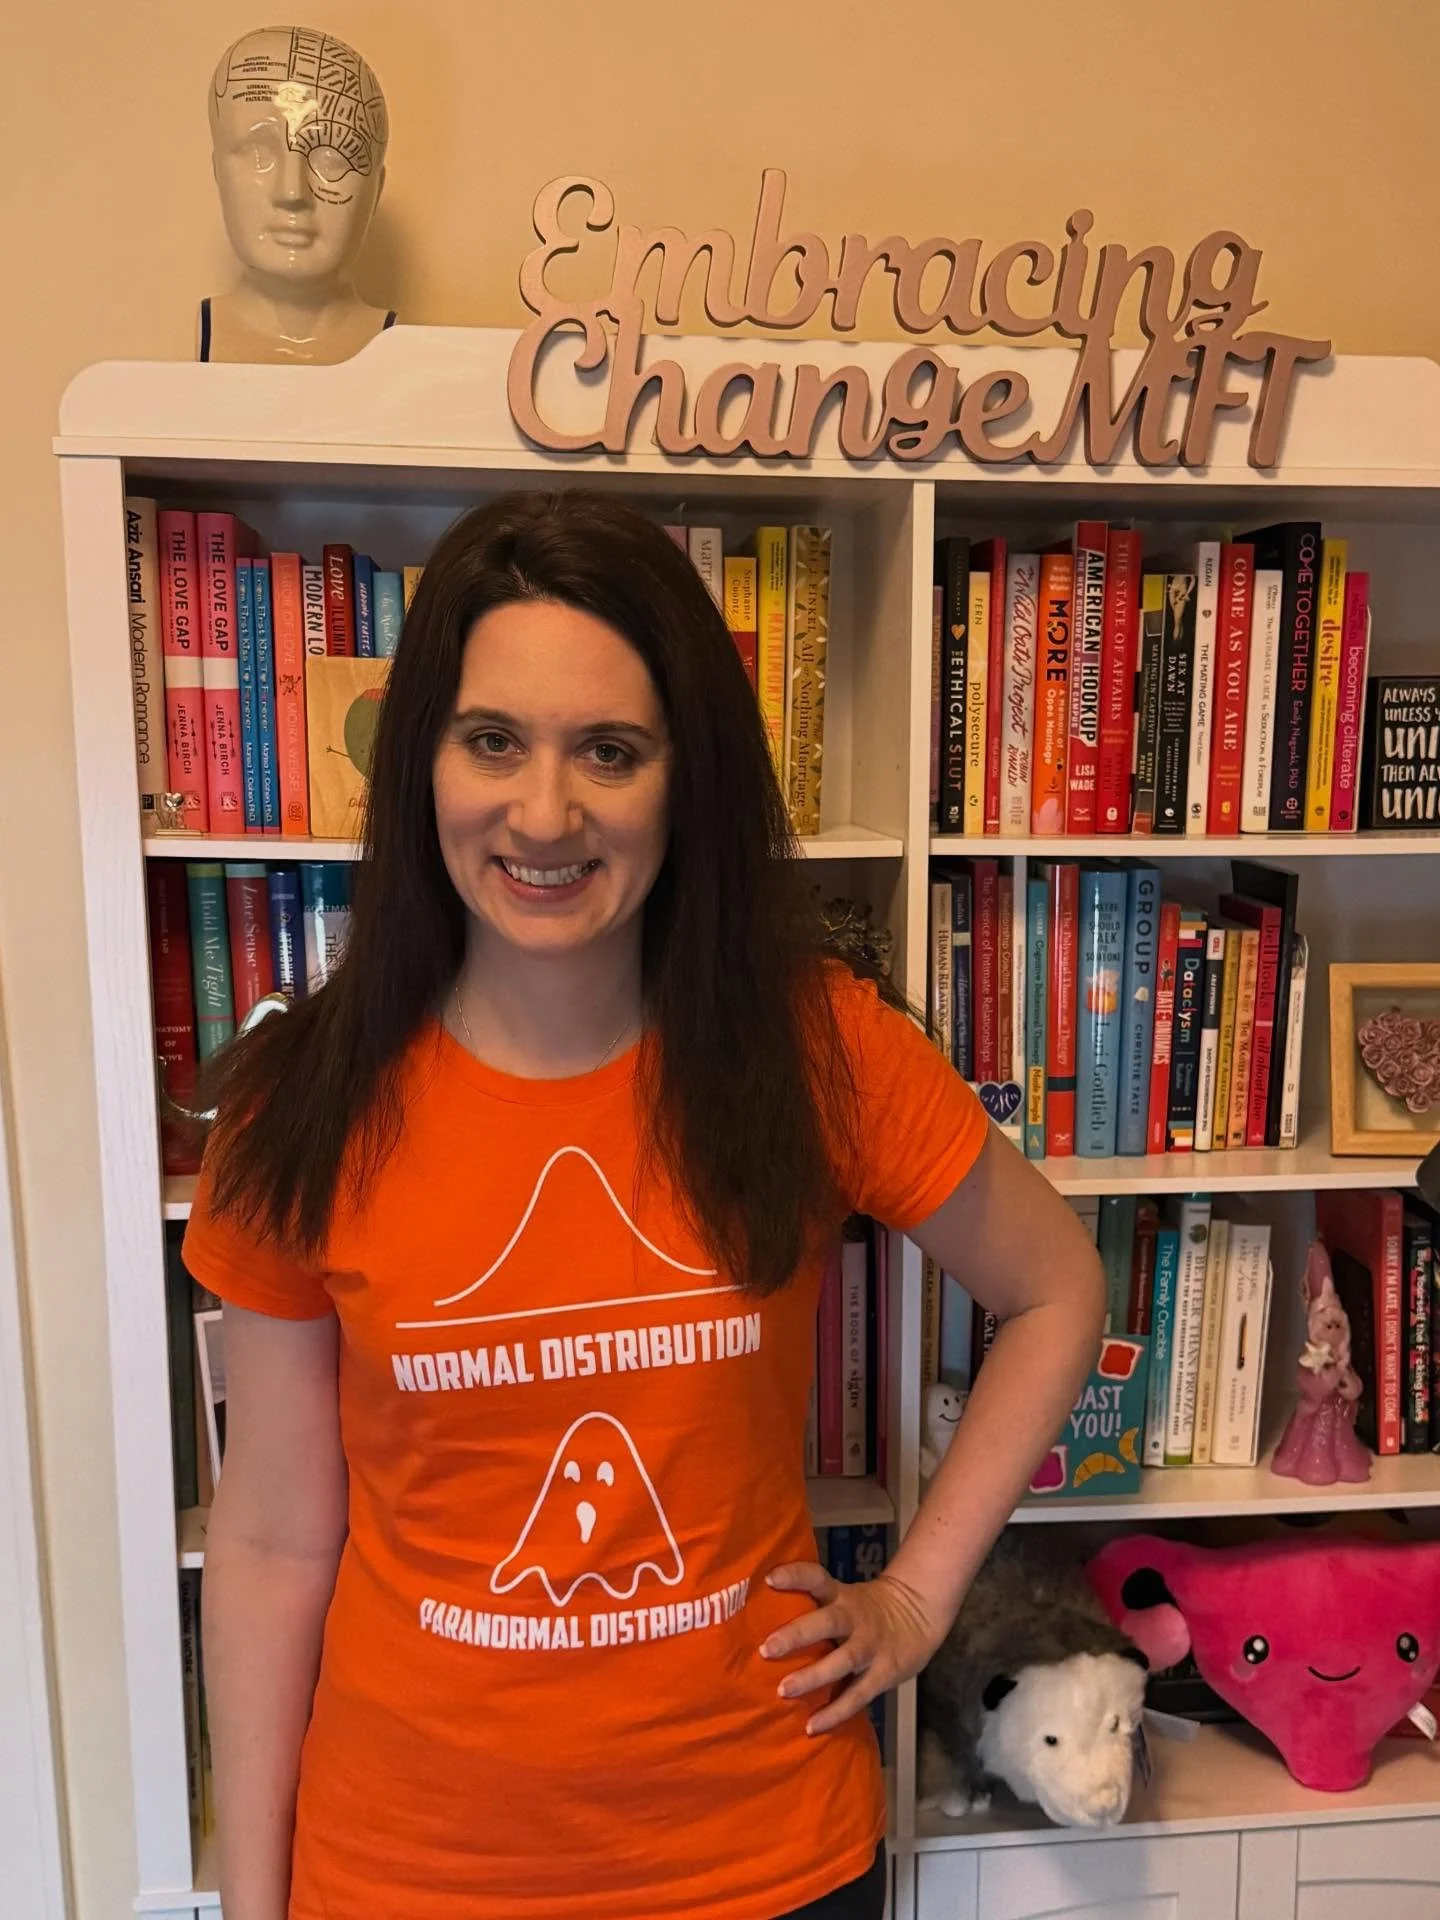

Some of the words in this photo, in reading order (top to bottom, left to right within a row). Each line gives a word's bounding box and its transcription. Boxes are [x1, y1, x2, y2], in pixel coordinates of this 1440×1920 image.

[518, 168, 1269, 343] Embracing
[127, 510, 142, 545] Aziz
[173, 530, 187, 560] THE
[211, 532, 225, 563] THE
[129, 550, 146, 604] Ansari
[1299, 533, 1316, 584] COME
[174, 567, 188, 612] LOVE
[213, 569, 227, 614] LOVE
[304, 570, 325, 630] MODERN
[1084, 552, 1105, 653] AMERICAN
[1114, 579, 1128, 624] STATE
[1230, 557, 1250, 618] COME
[176, 615, 191, 650] GAP
[974, 597, 984, 625] FERN
[132, 613, 150, 678] Modern
[215, 617, 229, 652] GAP
[1046, 599, 1071, 682] MORE
[1113, 632, 1126, 652] OF
[1200, 643, 1210, 662] THE
[1228, 626, 1243, 652] AS
[1290, 588, 1315, 691] TOGETHER
[1318, 618, 1341, 688] desire
[1165, 656, 1178, 692] DAWN
[1177, 653, 1189, 675] SEX
[1199, 665, 1210, 698] MATING
[1226, 659, 1243, 701] YOU
[1339, 646, 1365, 723] becoming
[797, 681, 816, 738] Nothing
[949, 657, 965, 738] ETHICAL
[1080, 665, 1101, 743] HOOKUP
[1111, 659, 1126, 721] AFFAIRS
[1176, 680, 1187, 696] AT
[1383, 687, 1436, 704] ALWAYS
[136, 682, 153, 764] Romance
[177, 704, 188, 738] JENNA
[216, 704, 227, 740] JENNA
[968, 681, 985, 768] polysecure
[1197, 702, 1207, 727] GAME
[1223, 708, 1239, 751] ARE
[181, 742, 192, 775] BIRCH
[220, 743, 231, 776] BIRCH
[795, 743, 812, 808] Marriage
[949, 743, 963, 791] SLUT
[1007, 743, 1021, 788] RINALDI
[1018, 750, 1031, 782] ROBIN
[1339, 725, 1358, 790] cliterate
[200, 891, 217, 932] Hold
[981, 897, 994, 938] Science
[1134, 879, 1156, 975] GROUP
[244, 924, 261, 969] Sense
[201, 964, 227, 1011] Tight
[981, 953, 993, 995] Intimate
[1177, 957, 1201, 1043] Dataclysm
[979, 996, 993, 1063] Relationships
[1132, 1022, 1144, 1078] CHRISTIE
[1091, 1062, 1109, 1131] Gottlieb
[1130, 1084, 1141, 1114] TATE
[1161, 1244, 1174, 1267] The
[1156, 1270, 1172, 1308] Family
[1191, 1256, 1206, 1319] BETTER
[391, 1343, 535, 1392] NORMAL
[539, 1312, 761, 1380] DISTRIBUTION
[1183, 1370, 1198, 1435] PROZAC
[1069, 1412, 1122, 1440] YOU!
[420, 1598, 584, 1650] PARANORMAL
[590, 1577, 750, 1648] DISTRIBUTION
